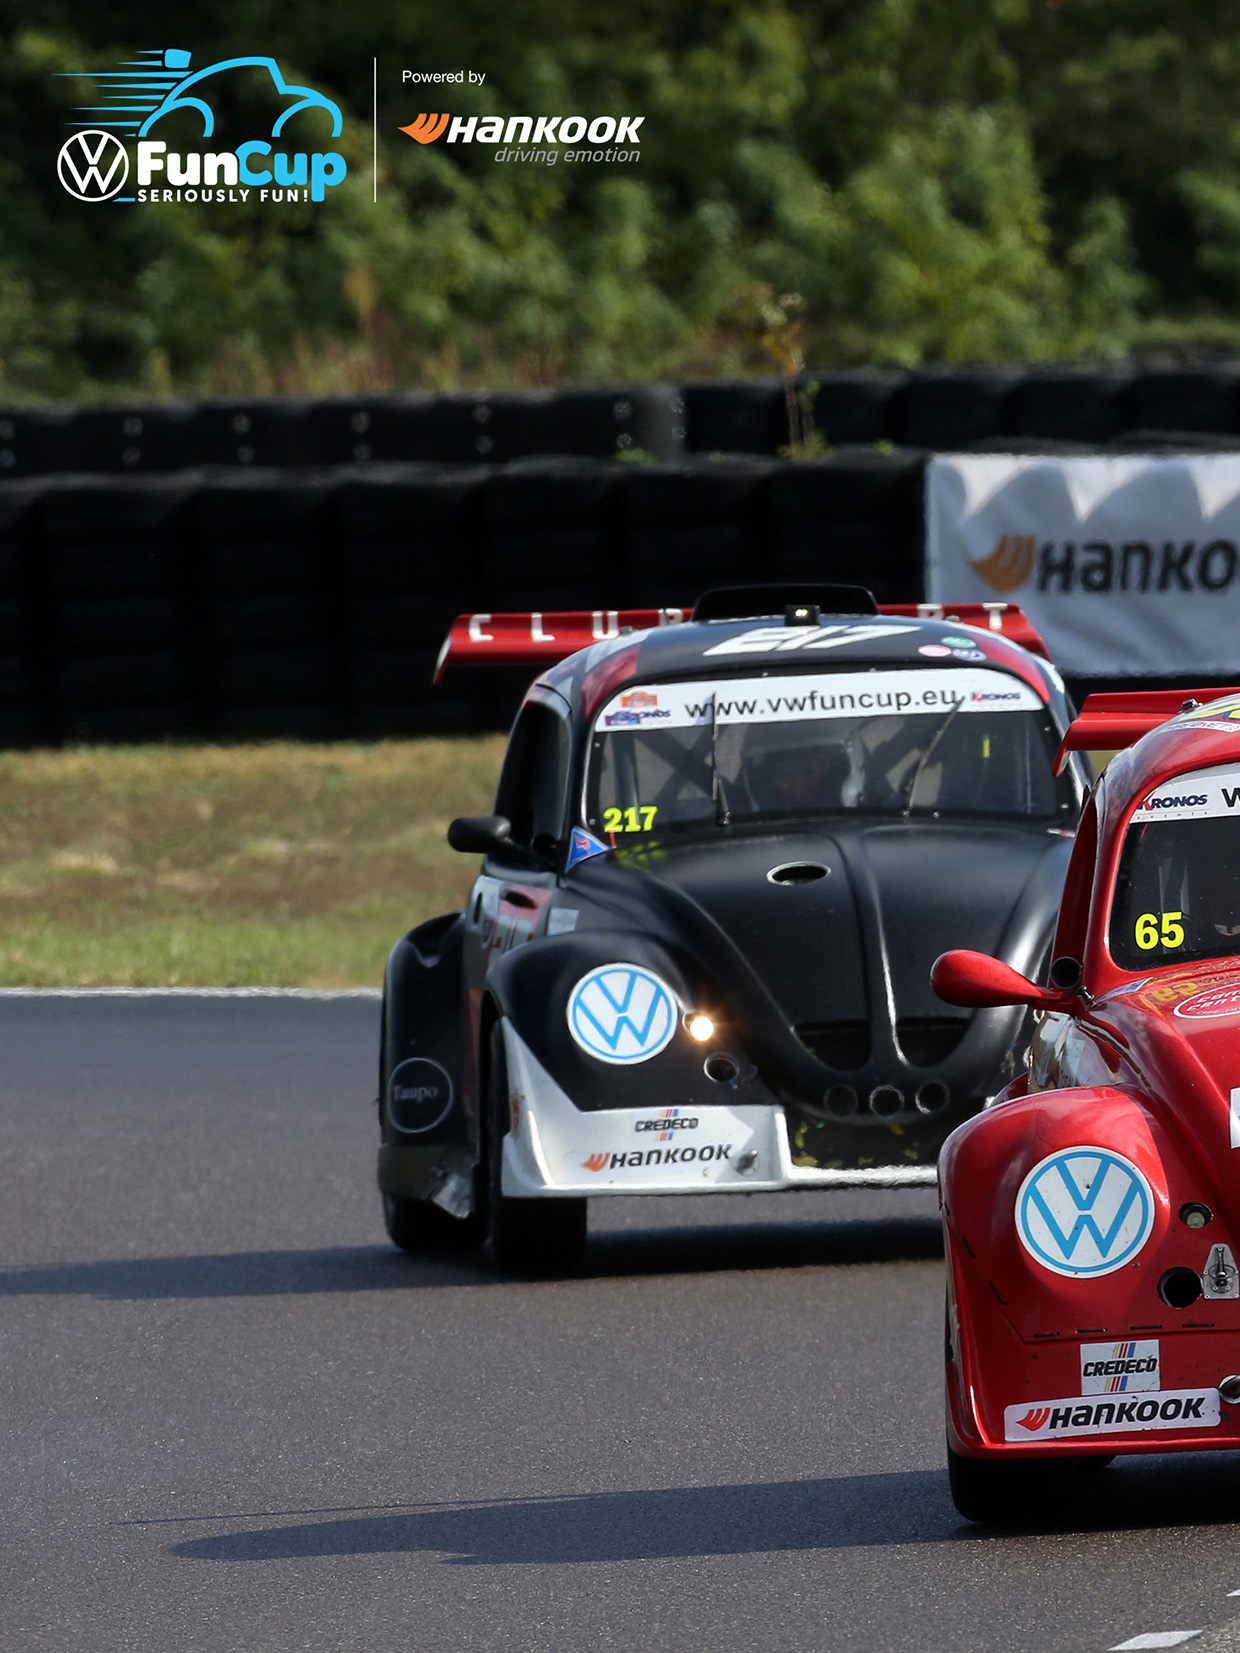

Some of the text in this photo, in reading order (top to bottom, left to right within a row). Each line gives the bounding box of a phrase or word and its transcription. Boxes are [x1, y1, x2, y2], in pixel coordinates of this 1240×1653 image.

[683, 689, 957, 718] www.vwfuncup.eu
[602, 805, 659, 833] 217
[1135, 911, 1185, 950] 65
[634, 1117, 700, 1133] CREDECO
[1083, 1358, 1158, 1378] CREDECO
